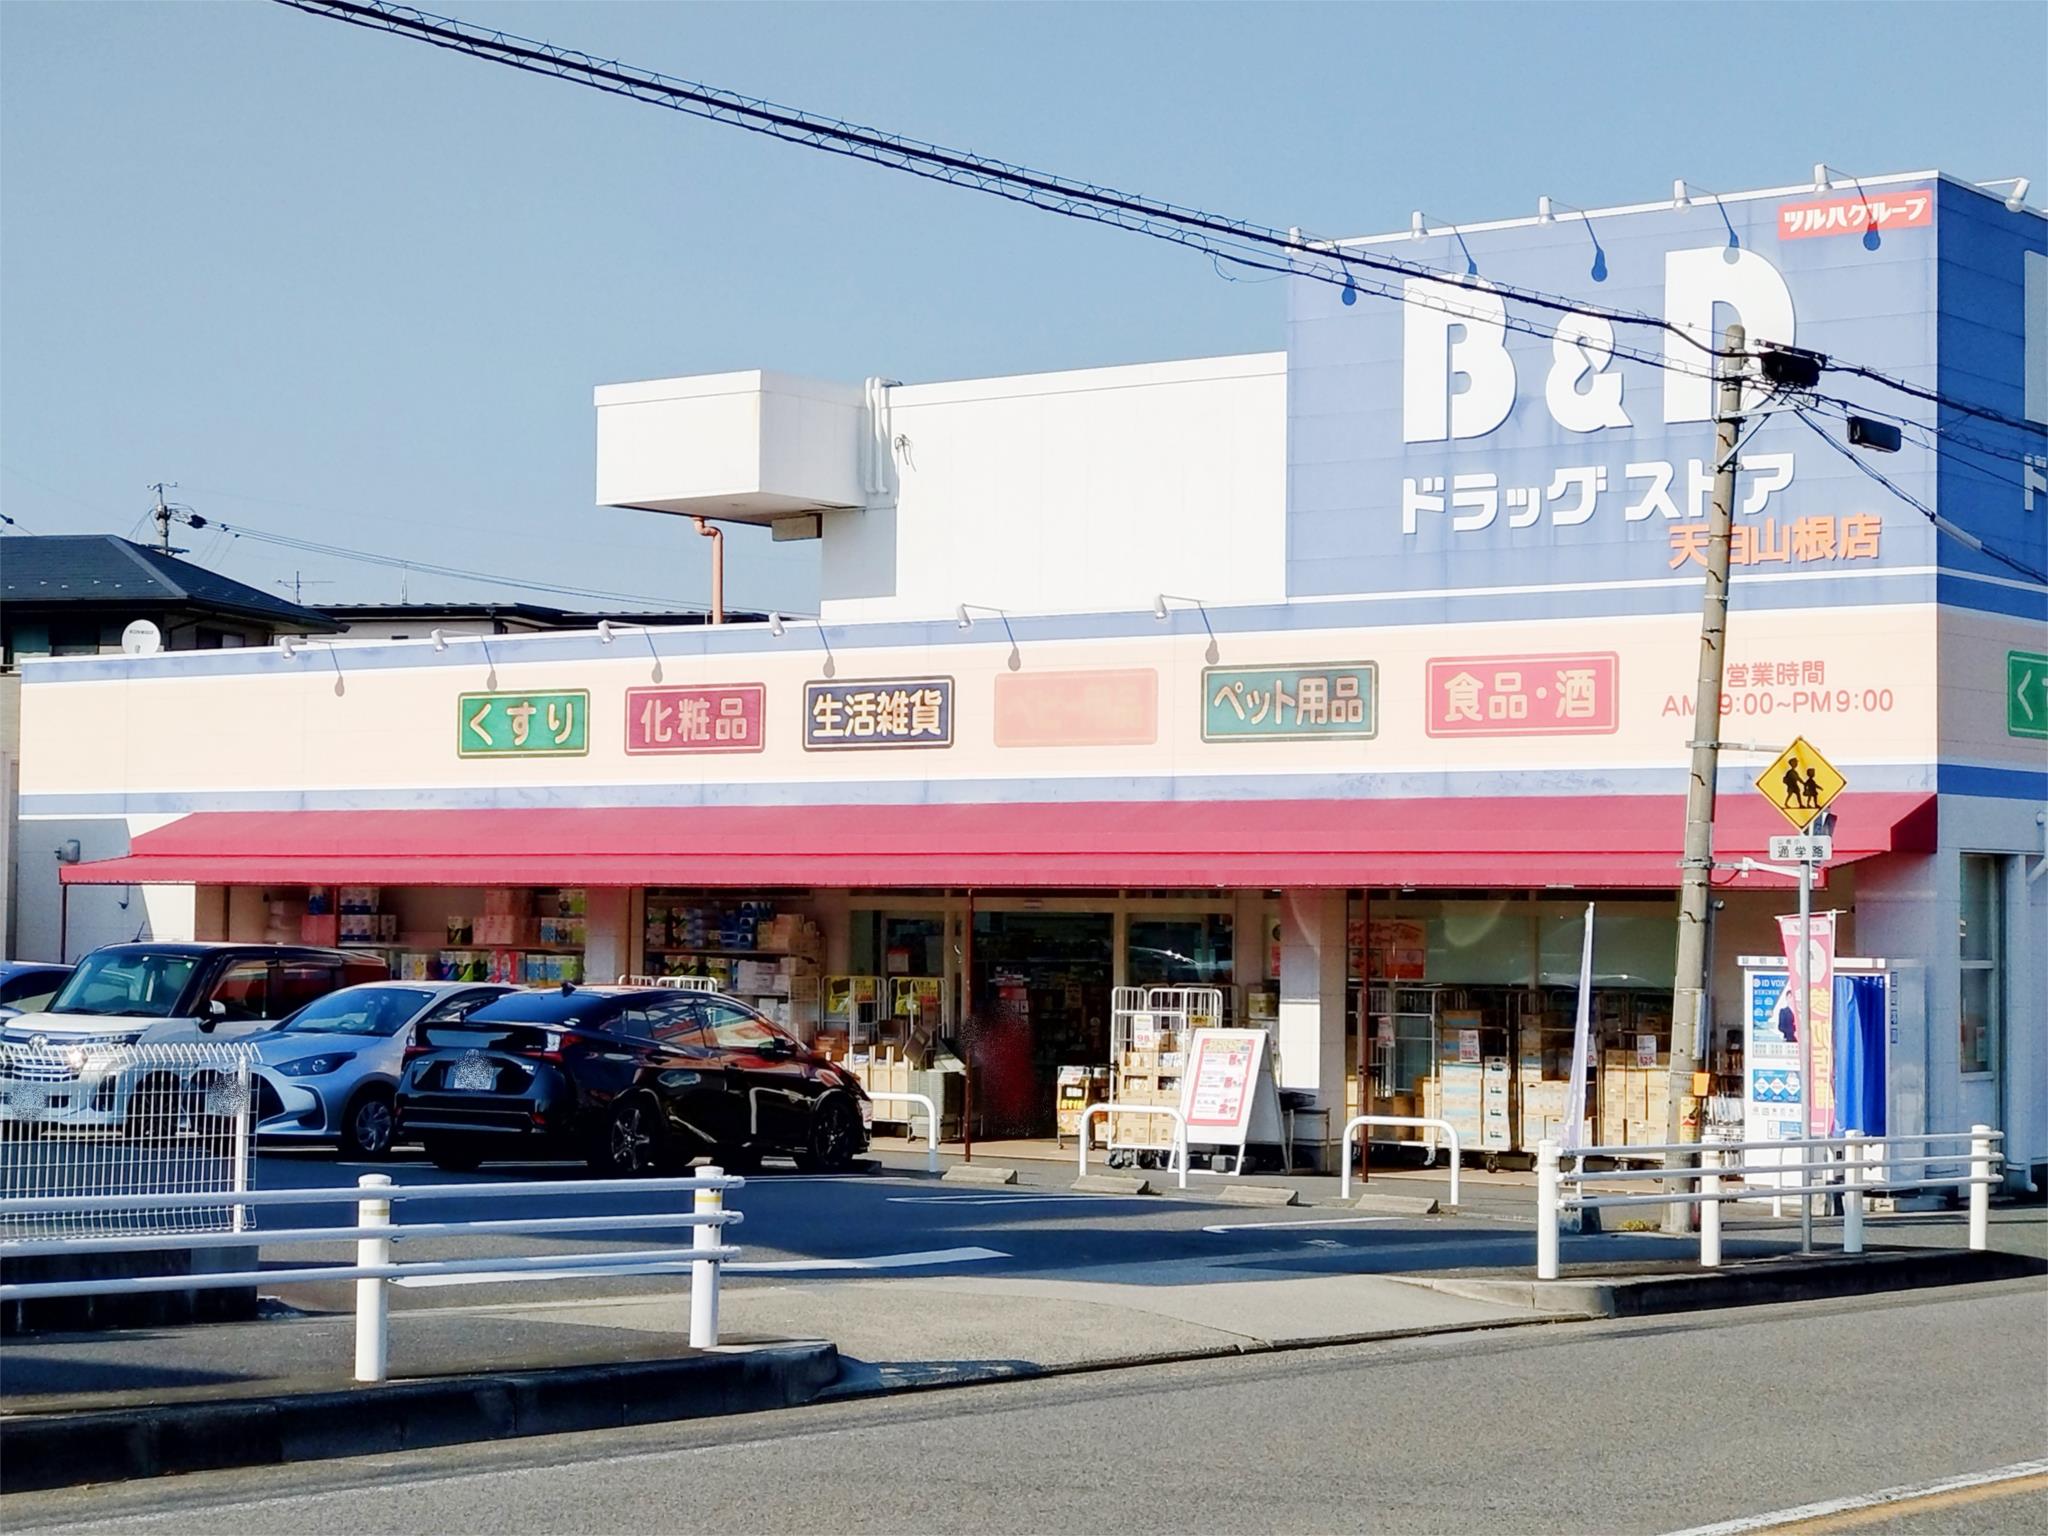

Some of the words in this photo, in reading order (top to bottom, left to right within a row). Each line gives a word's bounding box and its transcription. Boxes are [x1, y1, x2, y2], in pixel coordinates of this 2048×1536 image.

[1783, 197, 1928, 233] ツルハグループ
[1726, 660, 1826, 688] 営業時間
[639, 696, 748, 744] 化粧品
[812, 689, 945, 739] 生活雑貨
[1213, 675, 1365, 726] ペット用品
[469, 702, 575, 746] くすり
